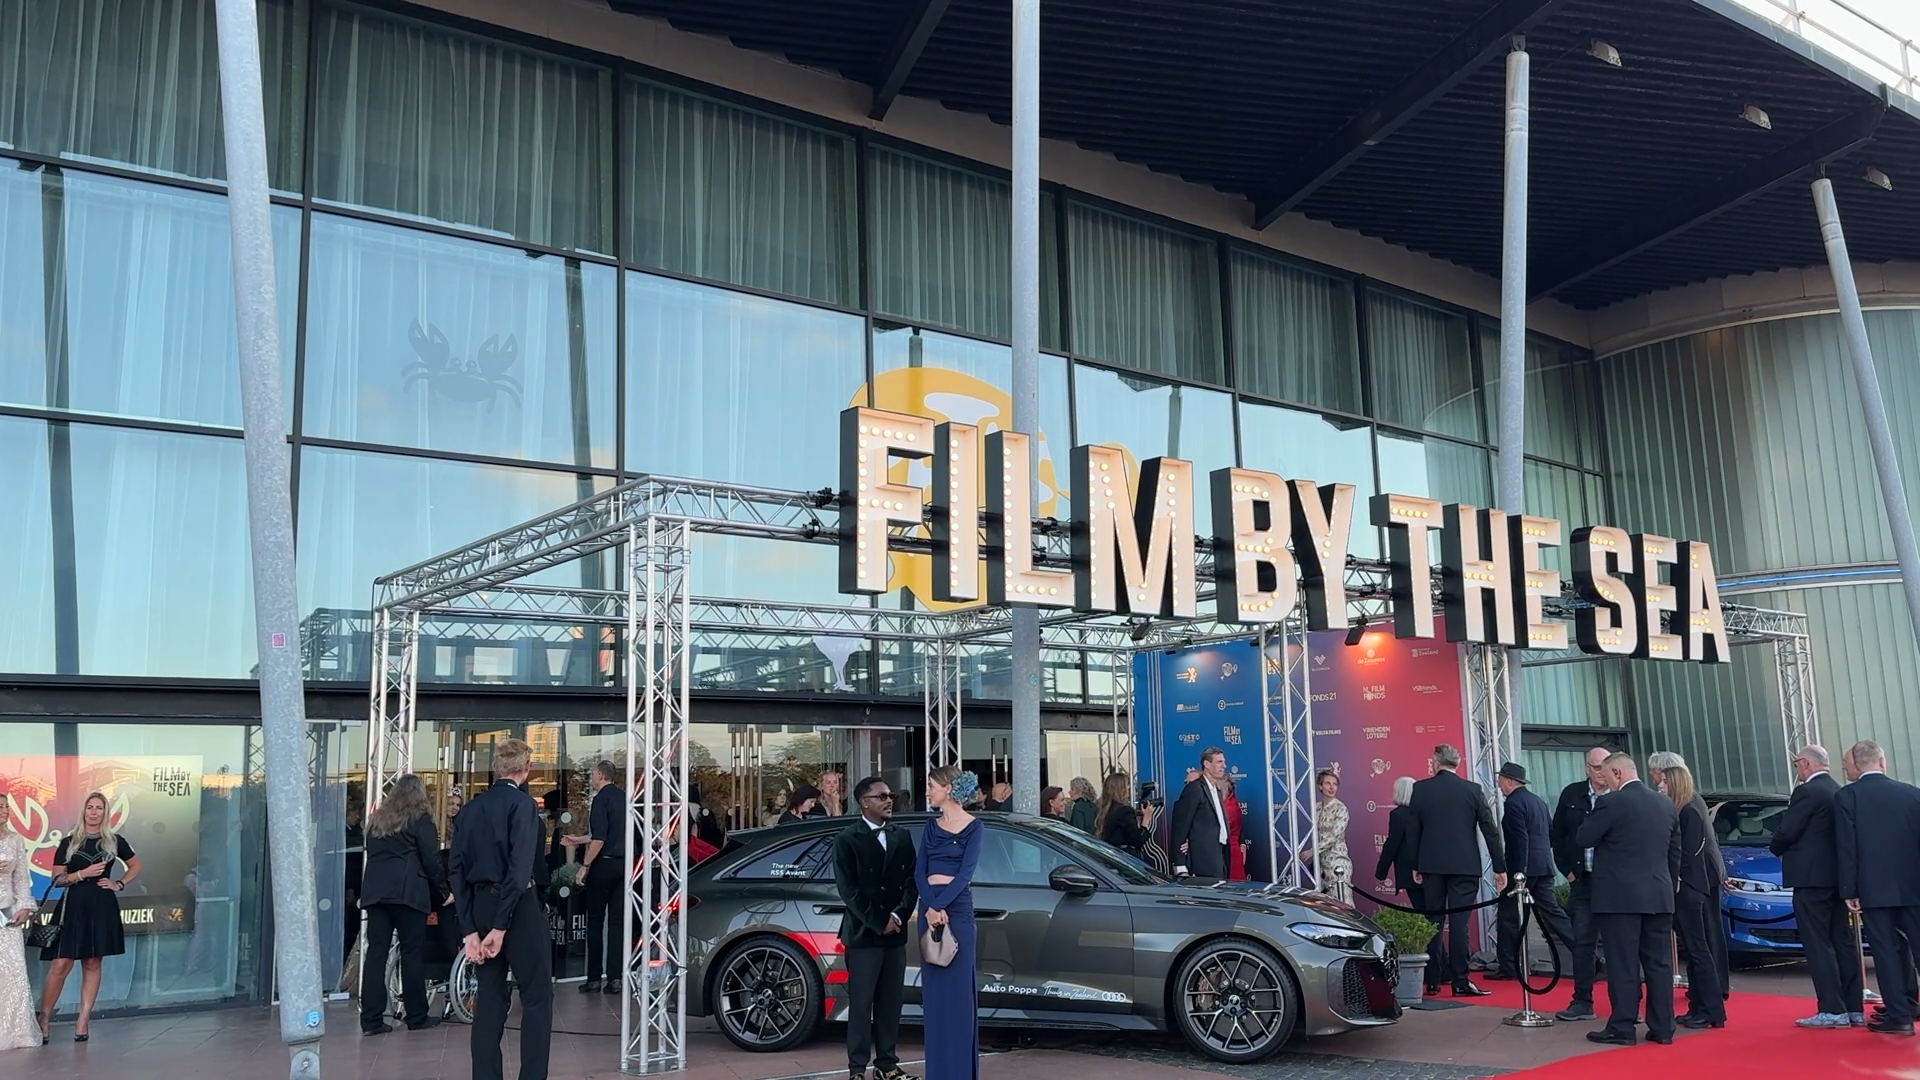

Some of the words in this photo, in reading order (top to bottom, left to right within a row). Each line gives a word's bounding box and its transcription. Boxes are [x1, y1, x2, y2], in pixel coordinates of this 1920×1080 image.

[839, 406, 1197, 619] FILM
[1210, 467, 1356, 631] BY
[1369, 493, 1568, 649] THE
[1570, 525, 1731, 664] SEA
[1371, 684, 1386, 692] FILM
[1329, 692, 1337, 701] 21
[1223, 725, 1236, 735] FILM
[1231, 735, 1242, 745] SEA
[153, 766, 181, 782] FILM
[180, 771, 191, 781] BY
[152, 782, 168, 792] THE
[168, 781, 191, 797] SEA
[983, 984, 1006, 992] Auto
[1008, 984, 1038, 994] Poppe
